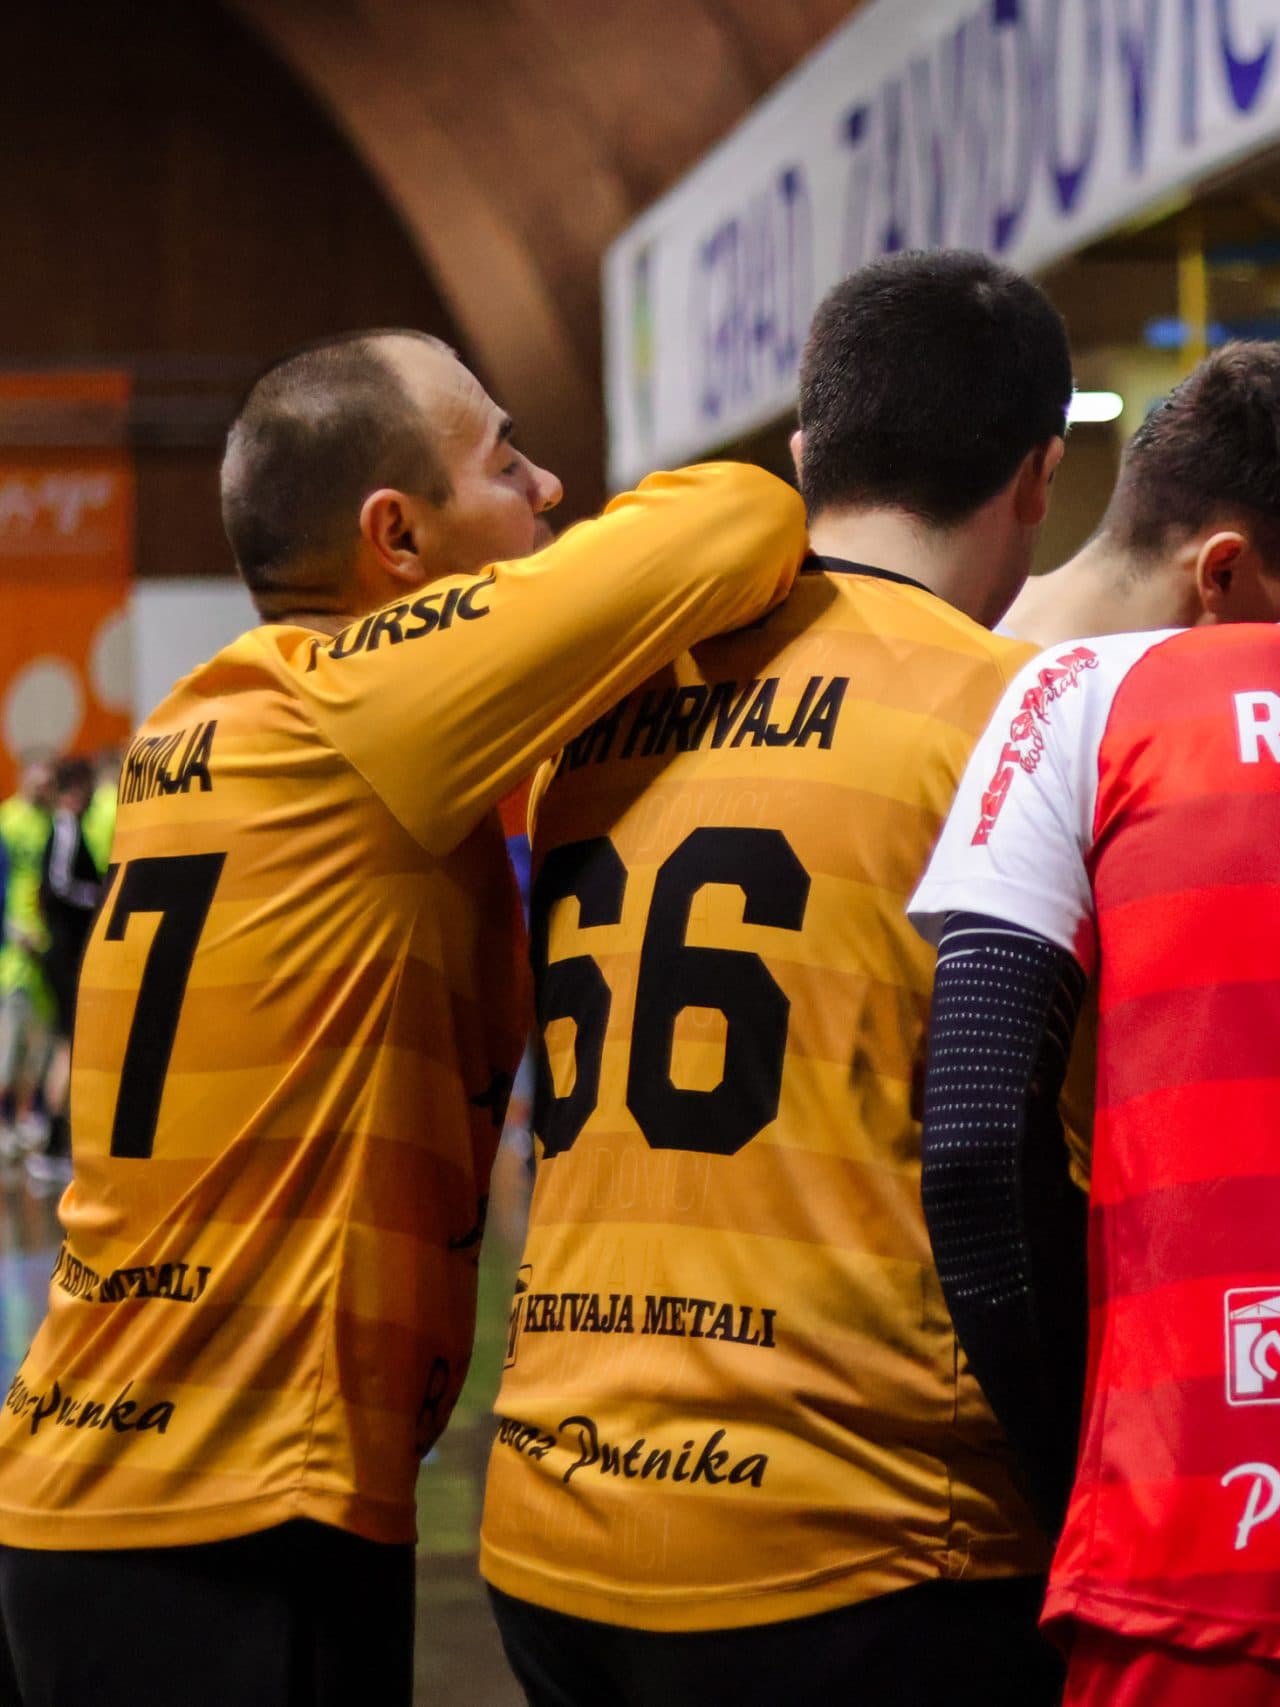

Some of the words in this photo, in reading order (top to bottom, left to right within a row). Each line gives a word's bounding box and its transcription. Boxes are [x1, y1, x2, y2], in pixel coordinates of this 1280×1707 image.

[530, 826, 812, 1160] 66
[523, 1293, 634, 1334] KRIVAJA
[641, 1295, 777, 1348] METALI
[558, 1415, 770, 1488] Putnika
